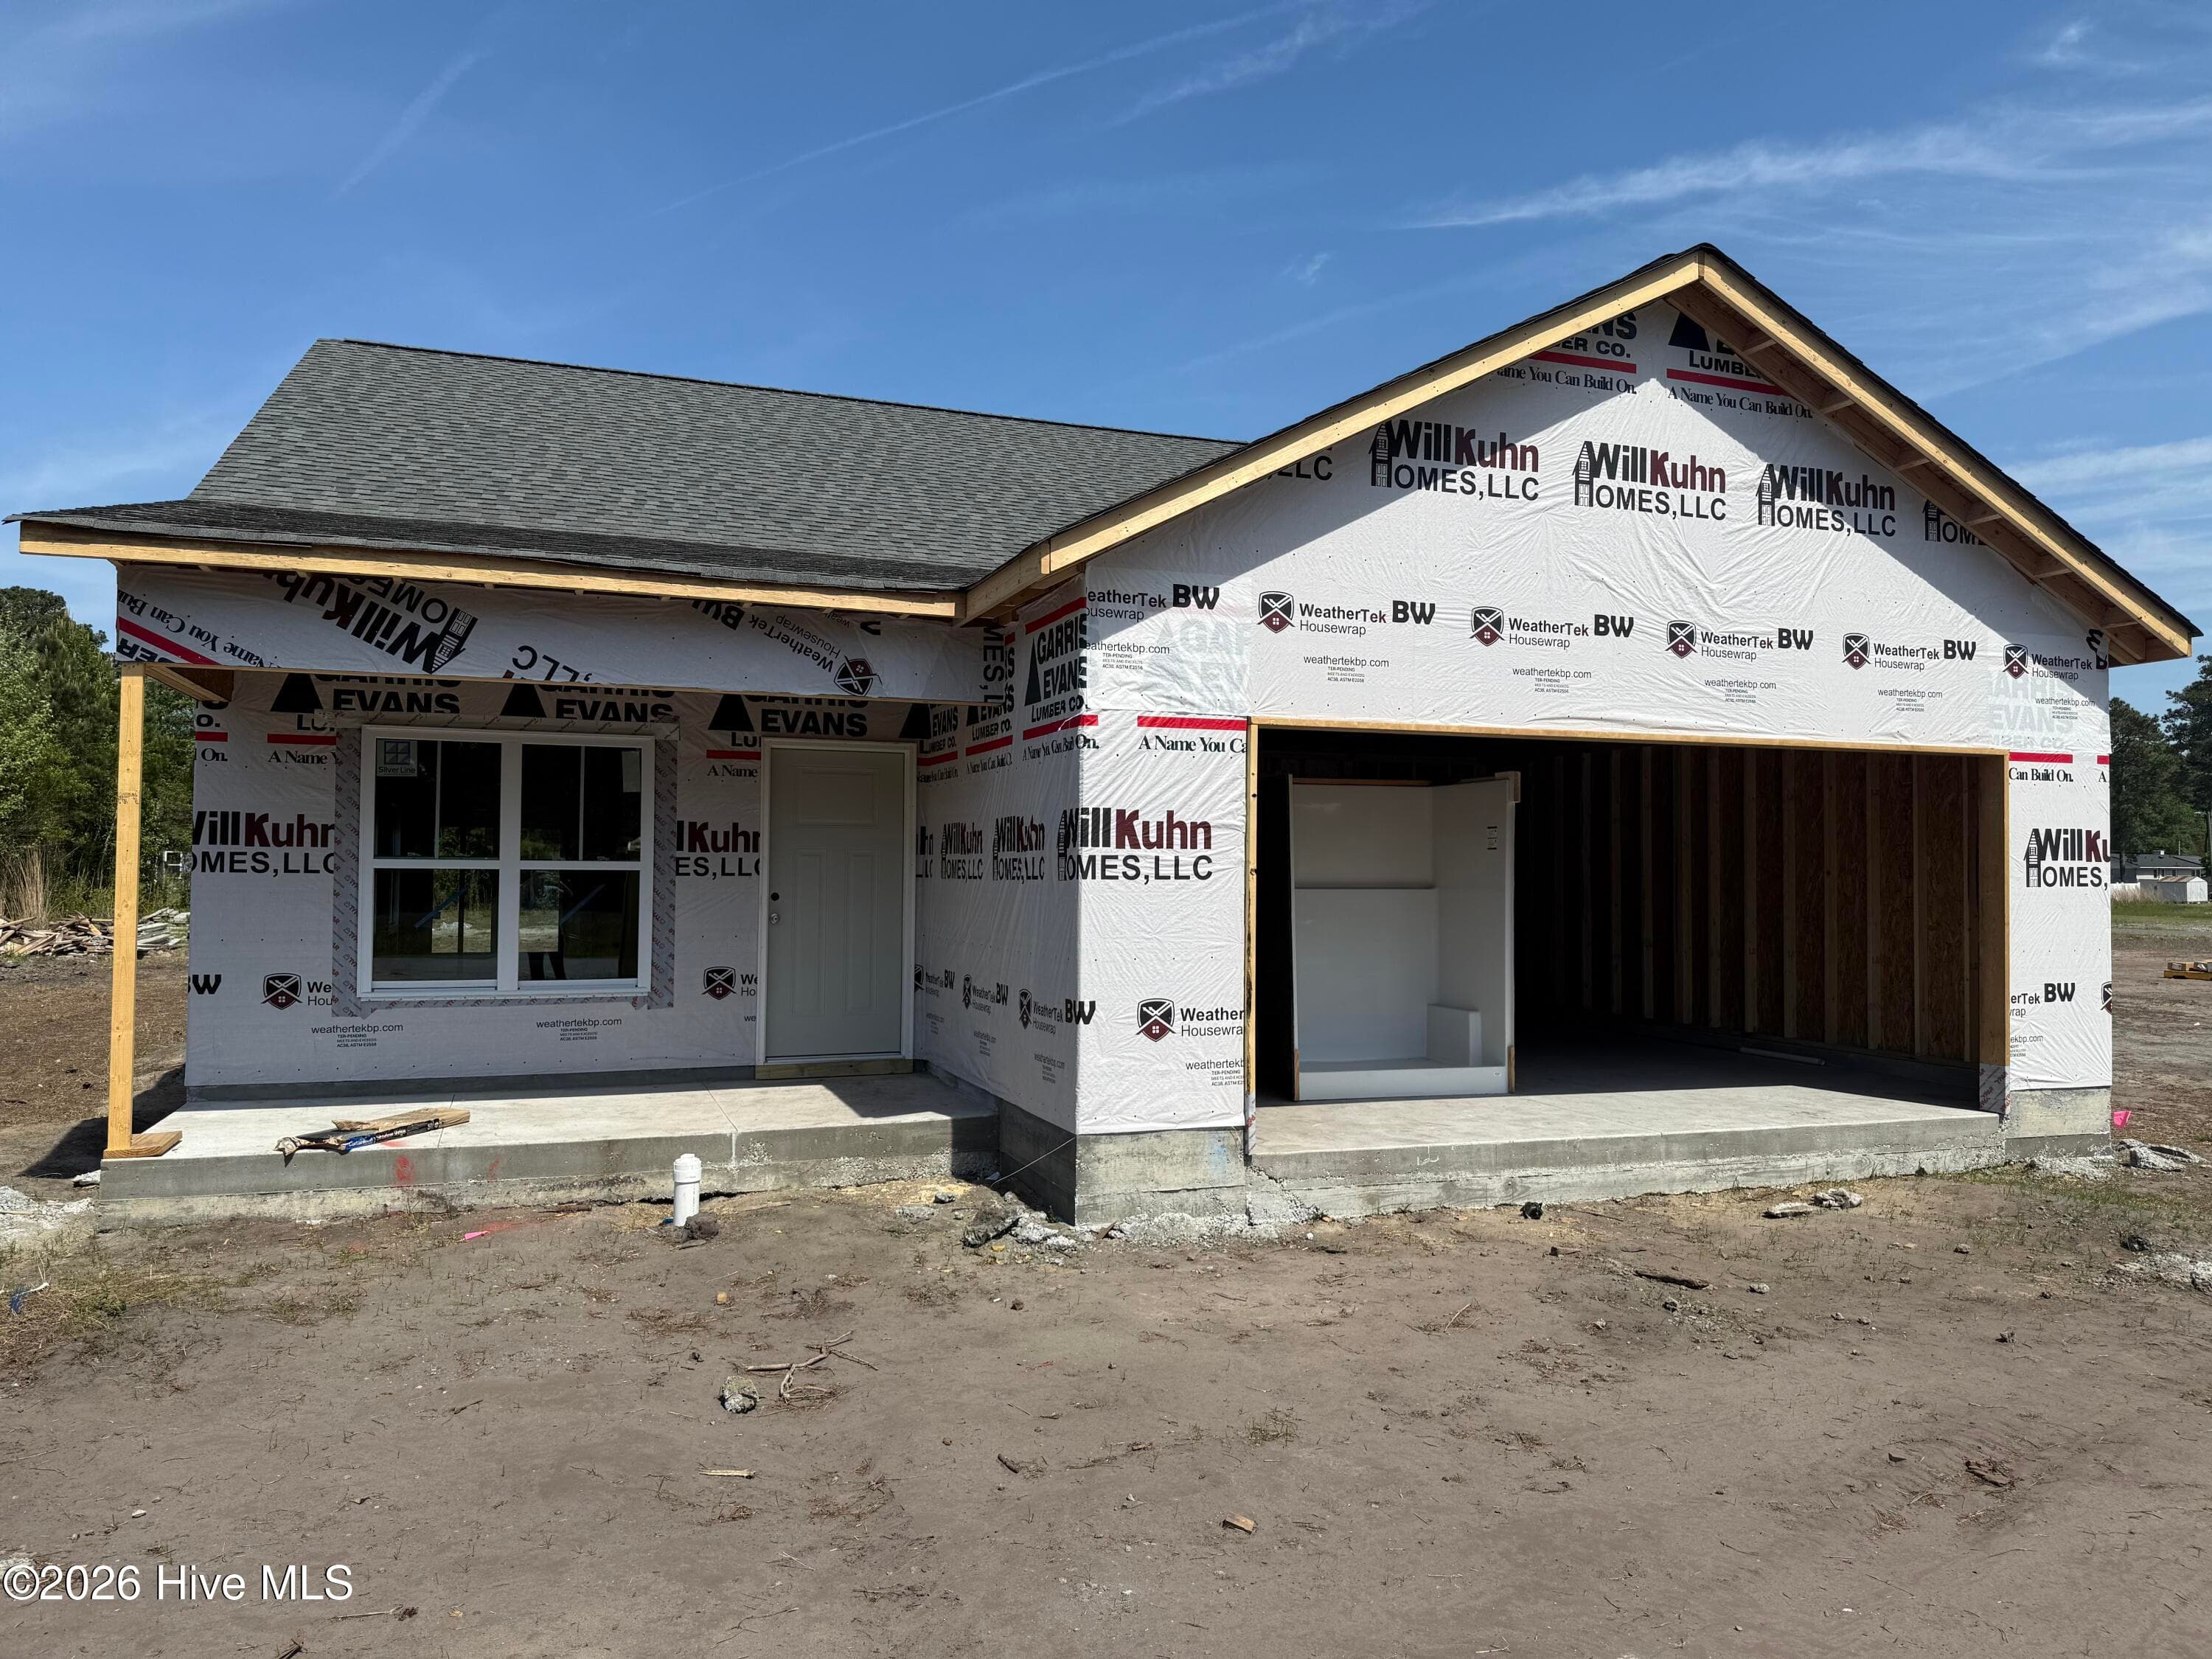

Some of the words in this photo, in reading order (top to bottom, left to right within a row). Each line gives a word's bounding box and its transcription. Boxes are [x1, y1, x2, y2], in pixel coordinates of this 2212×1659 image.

[1596, 340, 1631, 358] CO.
[1497, 366, 1526, 378] ame
[1529, 366, 1551, 383] You
[1555, 370, 1579, 386] Can
[1585, 374, 1613, 391] Build
[1616, 379, 1637, 394] On.
[1669, 386, 1678, 399] A
[1681, 387, 1714, 405] Name
[1716, 393, 1736, 408] You
[1739, 397, 1761, 413] Can
[1766, 400, 1792, 415] Build
[1385, 419, 1539, 473] WillKuhn
[1585, 440, 1725, 493] WillKuhn
[1767, 463, 1895, 512] WillKuhn
[1086, 588, 1167, 608] eatherTek
[1172, 584, 1220, 610] BW
[1299, 602, 1387, 624] WeatherTek
[1392, 599, 1436, 625] BW
[150, 606, 186, 633] Can
[189, 624, 220, 653] You
[1300, 619, 1366, 637] Housewrap
[1509, 617, 1589, 637] WeatherTek
[1594, 613, 1635, 638] BW
[748, 613, 834, 673] WeatherTek
[776, 614, 841, 659] Housewrap
[1509, 633, 1571, 650] Housewrap
[1700, 631, 1774, 650] WeatherTek
[1778, 627, 1814, 650] BW
[1701, 646, 1757, 662] Housewrap
[1873, 643, 1940, 660] WeatherTek
[1944, 639, 1977, 661] BW
[1304, 655, 1389, 668] weathertekbp.com
[1874, 657, 1925, 671] Housewrap
[2031, 653, 2093, 669] WeatherTek
[1043, 655, 1088, 700] EVANS
[1512, 667, 1592, 680] weathertekbp.com
[1705, 678, 1776, 690] weathertekbp.com
[2031, 667, 2079, 682] Housewrap
[333, 689, 461, 714] EVANS
[1877, 688, 1943, 700] weathertekbp.com
[2035, 697, 2096, 707] weathertekbp.com
[556, 698, 674, 723] EVANS
[1032, 698, 1066, 723] LUMBER
[761, 709, 868, 737] EVANS
[932, 706, 959, 737] EVANS
[972, 722, 999, 741] LUMBER
[1001, 718, 1012, 733] CO.
[1076, 734, 1099, 750] On.
[1138, 736, 1151, 750] A
[1155, 735, 1196, 751] Name
[1199, 737, 1225, 753] You
[201, 748, 228, 762] On.
[268, 750, 280, 762] A
[285, 750, 328, 764] Name
[707, 765, 719, 776] A
[721, 764, 758, 778] Name
[2008, 768, 2028, 782] Can
[2031, 768, 2054, 782] Build
[2056, 769, 2073, 782] On.
[2098, 771, 2107, 782] A
[944, 821, 983, 855] WillKuhn
[1062, 807, 1211, 850] WillKuhn
[307, 981, 332, 993] We
[945, 968, 956, 990] BW
[307, 995, 333, 1006] Hou
[972, 984, 996, 1004] WeatherTek
[996, 982, 1009, 1006] BW
[2044, 982, 2076, 1003] BW
[1033, 1001, 1063, 1023] WeatherTek
[1065, 998, 1096, 1025] BW
[2009, 1008, 2026, 1018] rap
[311, 1023, 403, 1034] weathertekbp.com
[536, 1018, 622, 1029] weathertekbp.com
